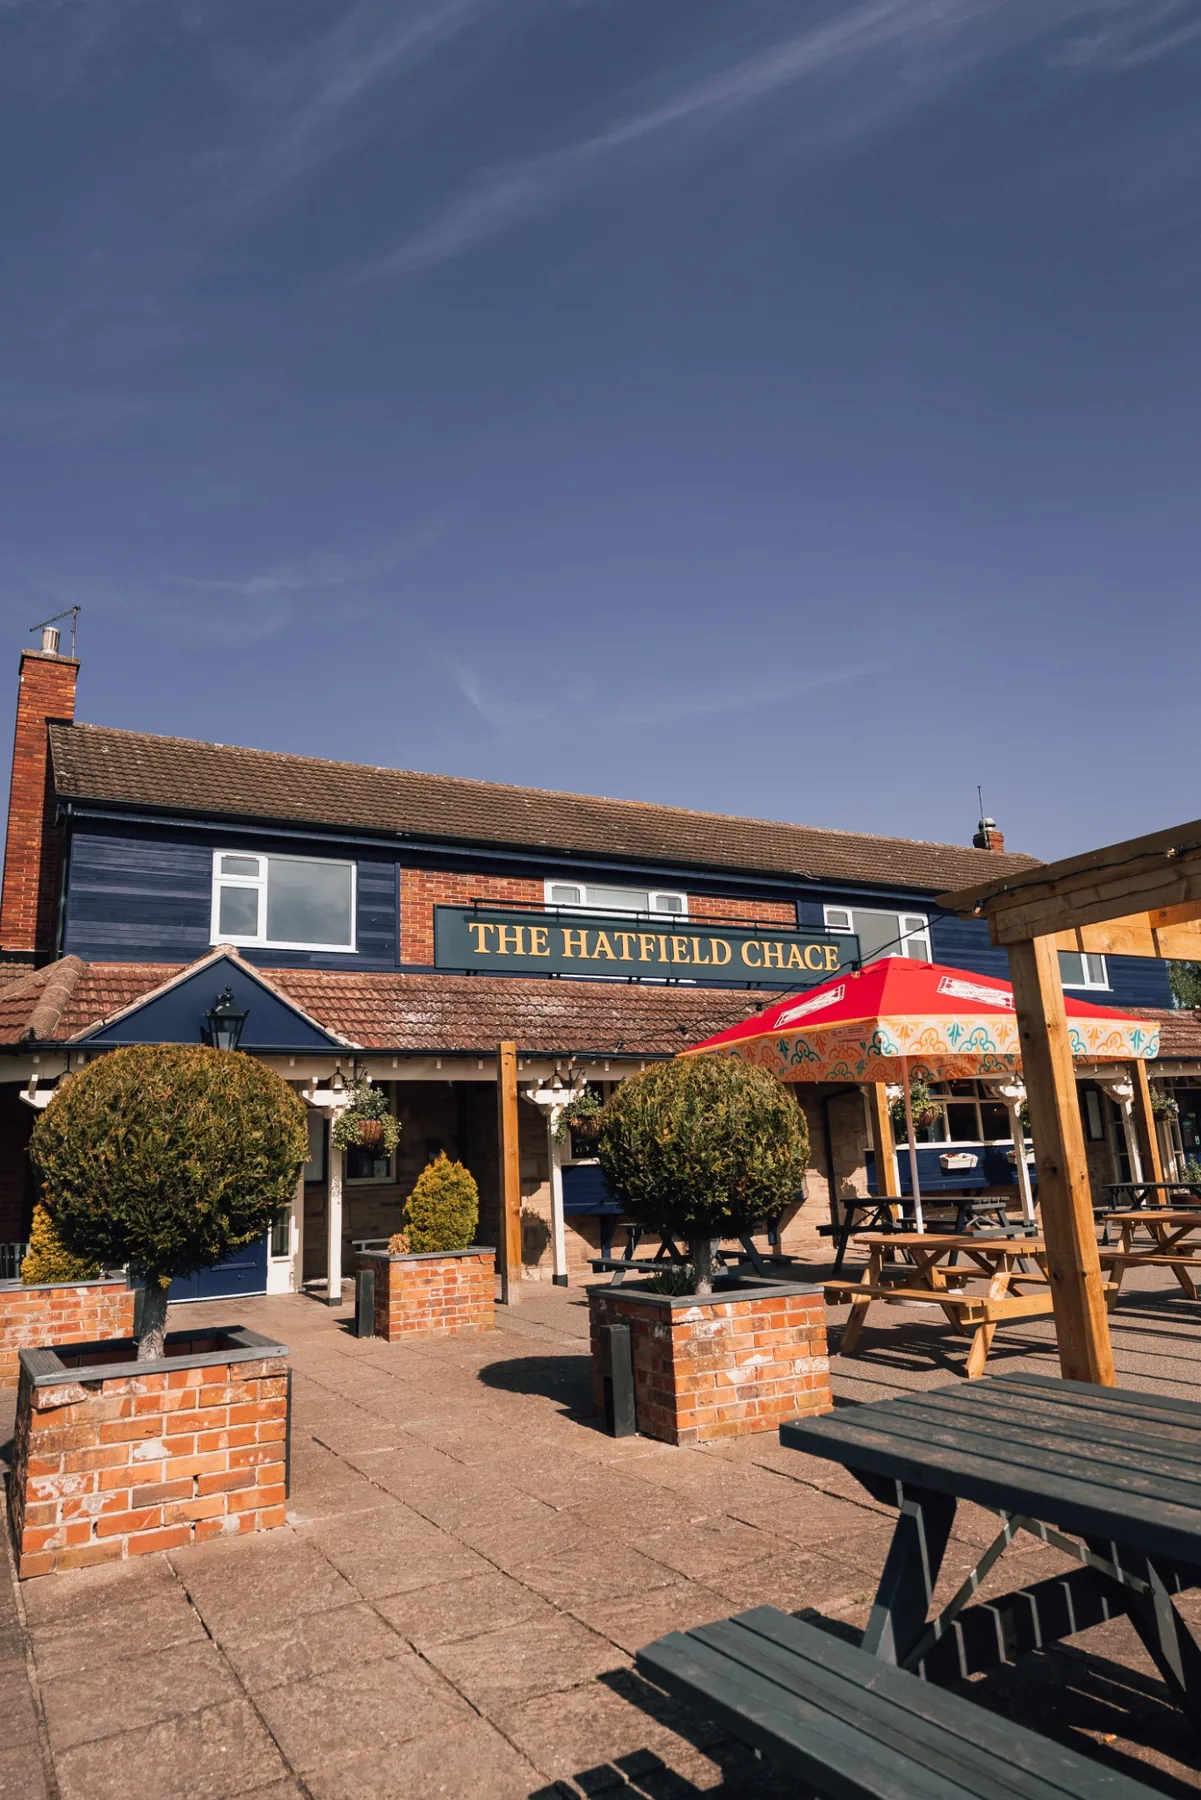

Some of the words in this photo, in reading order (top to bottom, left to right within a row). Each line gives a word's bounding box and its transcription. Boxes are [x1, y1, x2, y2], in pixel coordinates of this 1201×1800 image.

[468, 923, 551, 957] THE
[561, 928, 733, 966] HATFIELD
[740, 940, 841, 972] CHACE
